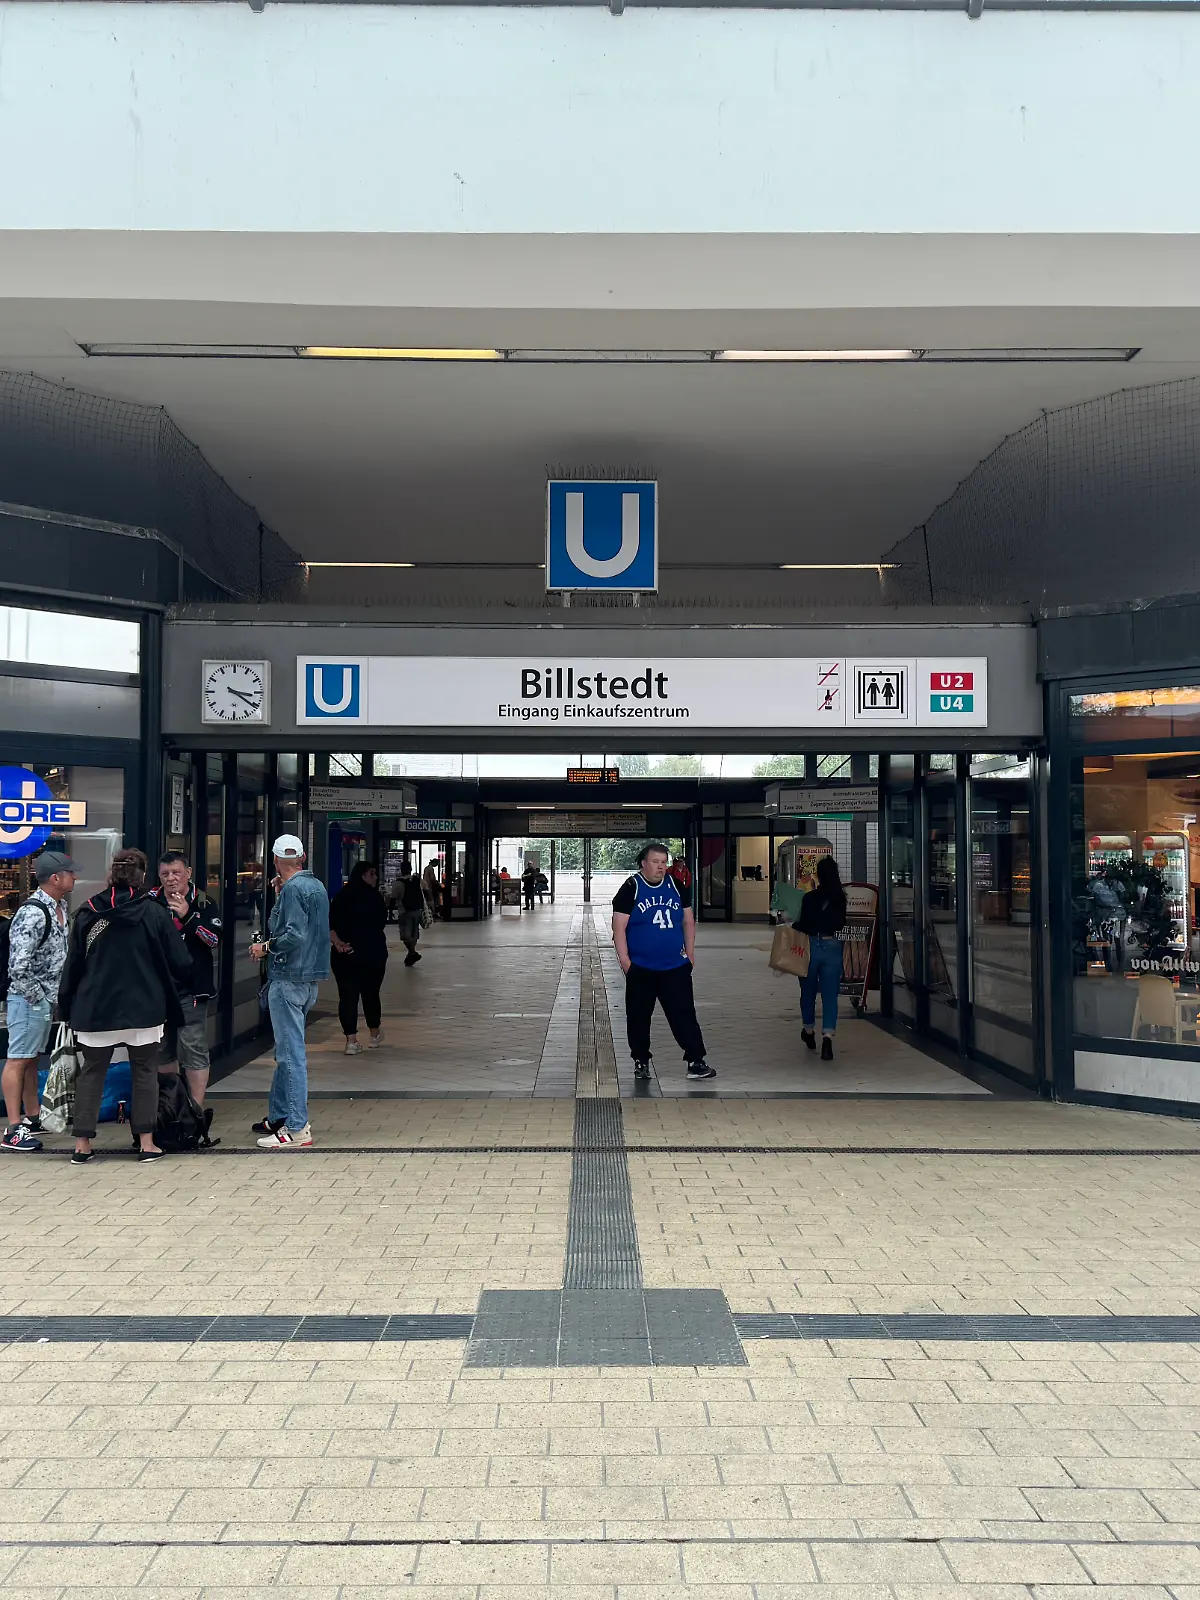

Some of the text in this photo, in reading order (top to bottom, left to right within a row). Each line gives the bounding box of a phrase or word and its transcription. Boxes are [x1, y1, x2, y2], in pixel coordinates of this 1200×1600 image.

[566, 492, 640, 578] U
[313, 667, 353, 714] U
[521, 667, 669, 699] Billstedt
[498, 703, 690, 721] Eingang Einkaufszentrum
[940, 696, 965, 711] U4
[0, 801, 70, 823] ORE
[406, 820, 457, 831] backWERK
[637, 895, 680, 914] DALLAS
[652, 908, 674, 929] 41
[1131, 958, 1160, 971] von
